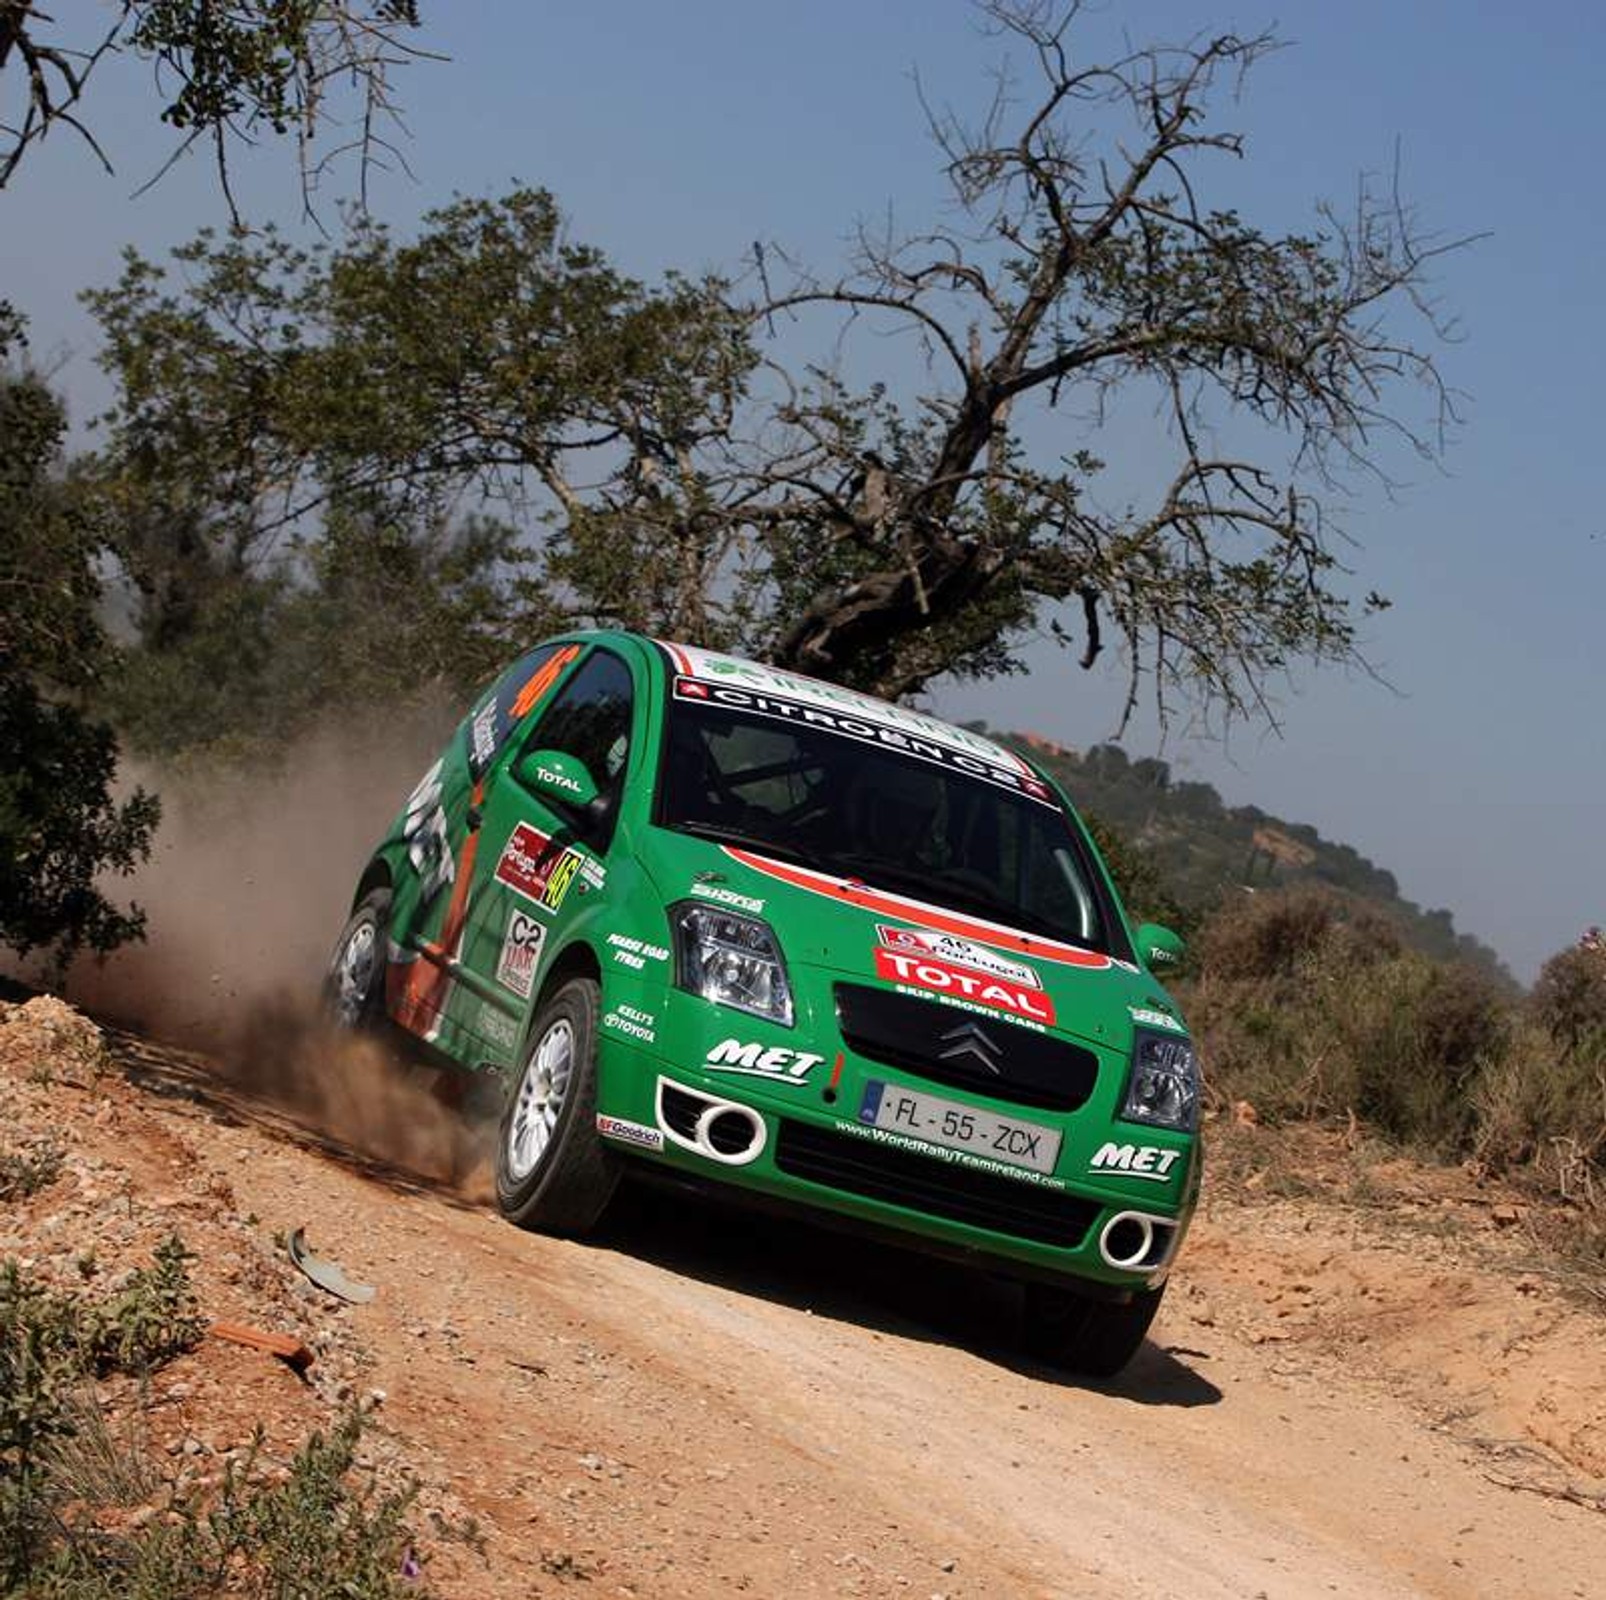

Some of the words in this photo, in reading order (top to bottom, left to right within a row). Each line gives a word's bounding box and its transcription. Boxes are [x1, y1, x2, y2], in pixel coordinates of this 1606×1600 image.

[536, 766, 582, 793] TOTAL
[512, 916, 541, 954] C2
[882, 951, 1047, 1018] TOTAL
[617, 1019, 656, 1043] TOYOTA
[939, 995, 1000, 1019] BROWN
[1003, 1013, 1047, 1033] CARS
[706, 1037, 826, 1077] MET
[895, 1098, 921, 1128] FL
[941, 1110, 976, 1142] 55
[992, 1124, 1041, 1160] ZCX
[1089, 1142, 1182, 1174] MET
